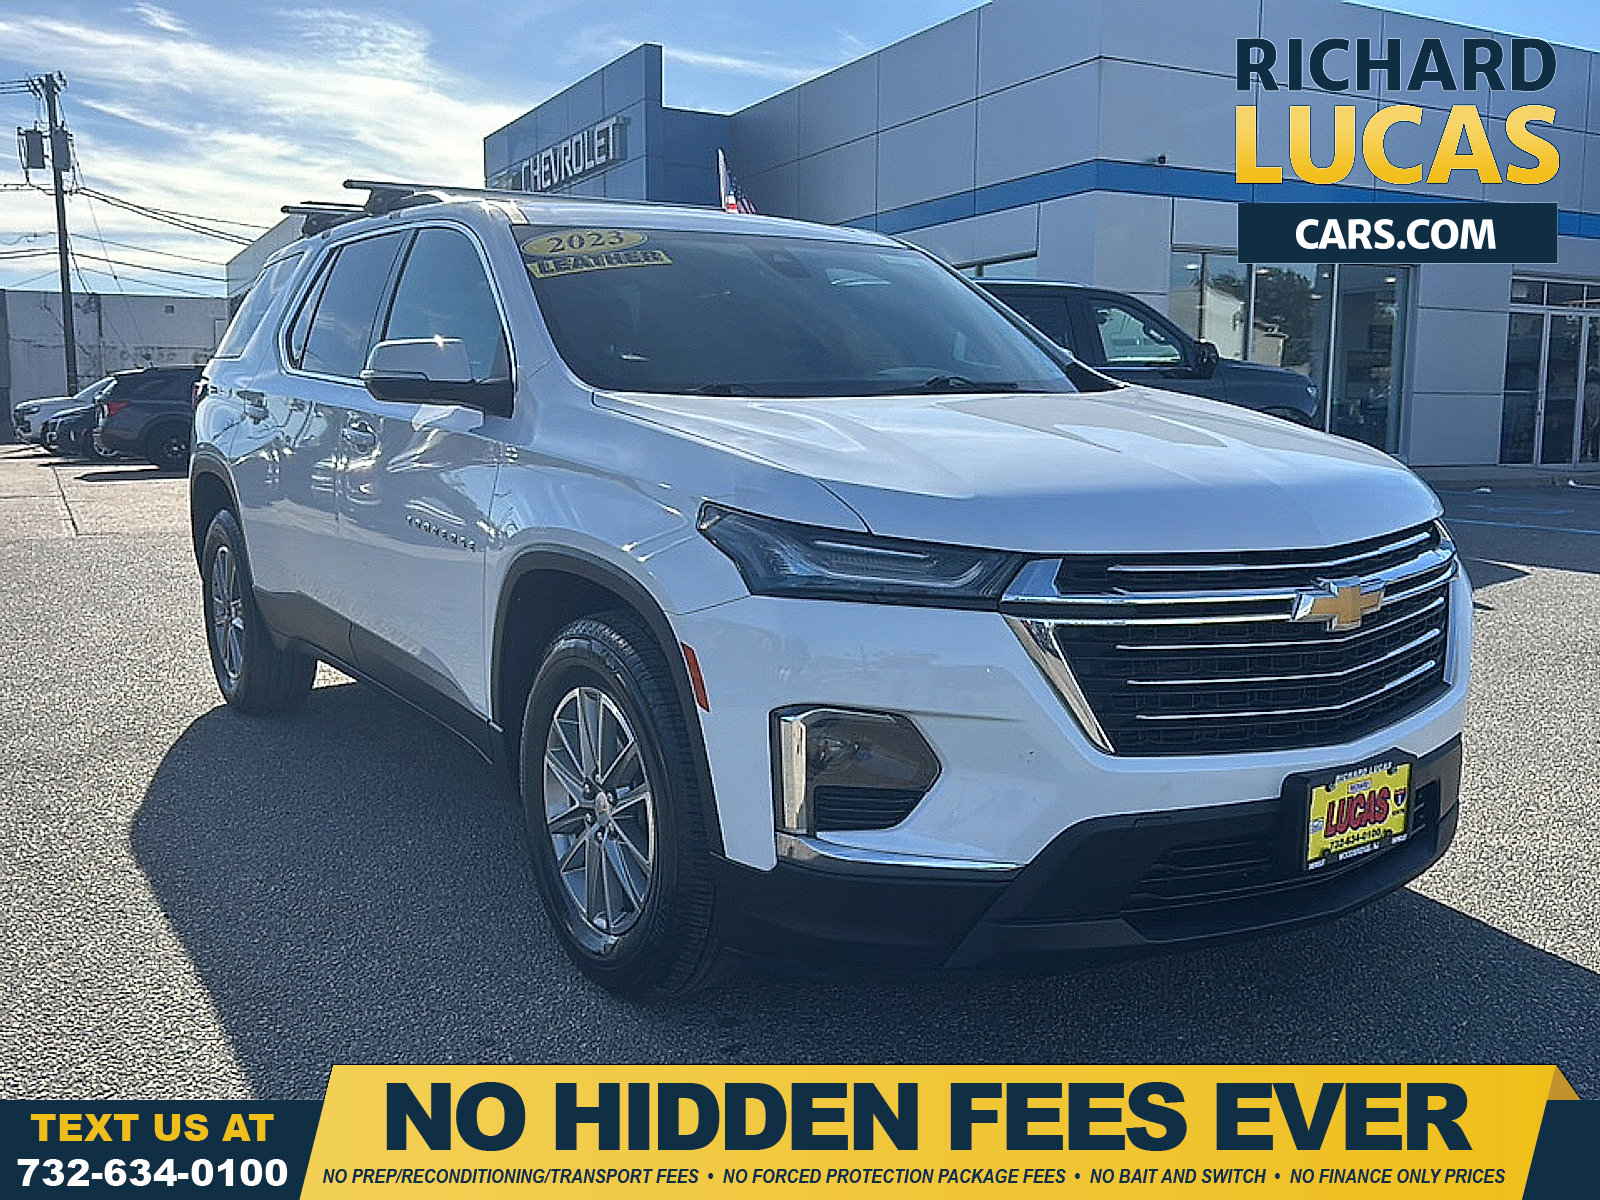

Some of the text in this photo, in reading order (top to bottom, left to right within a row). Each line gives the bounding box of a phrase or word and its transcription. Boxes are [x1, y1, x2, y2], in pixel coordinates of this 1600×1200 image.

[521, 116, 624, 192] CHEVROLET
[546, 230, 625, 252] 2023
[535, 250, 667, 275] LEATHER
[1323, 786, 1391, 838] LUCAS
